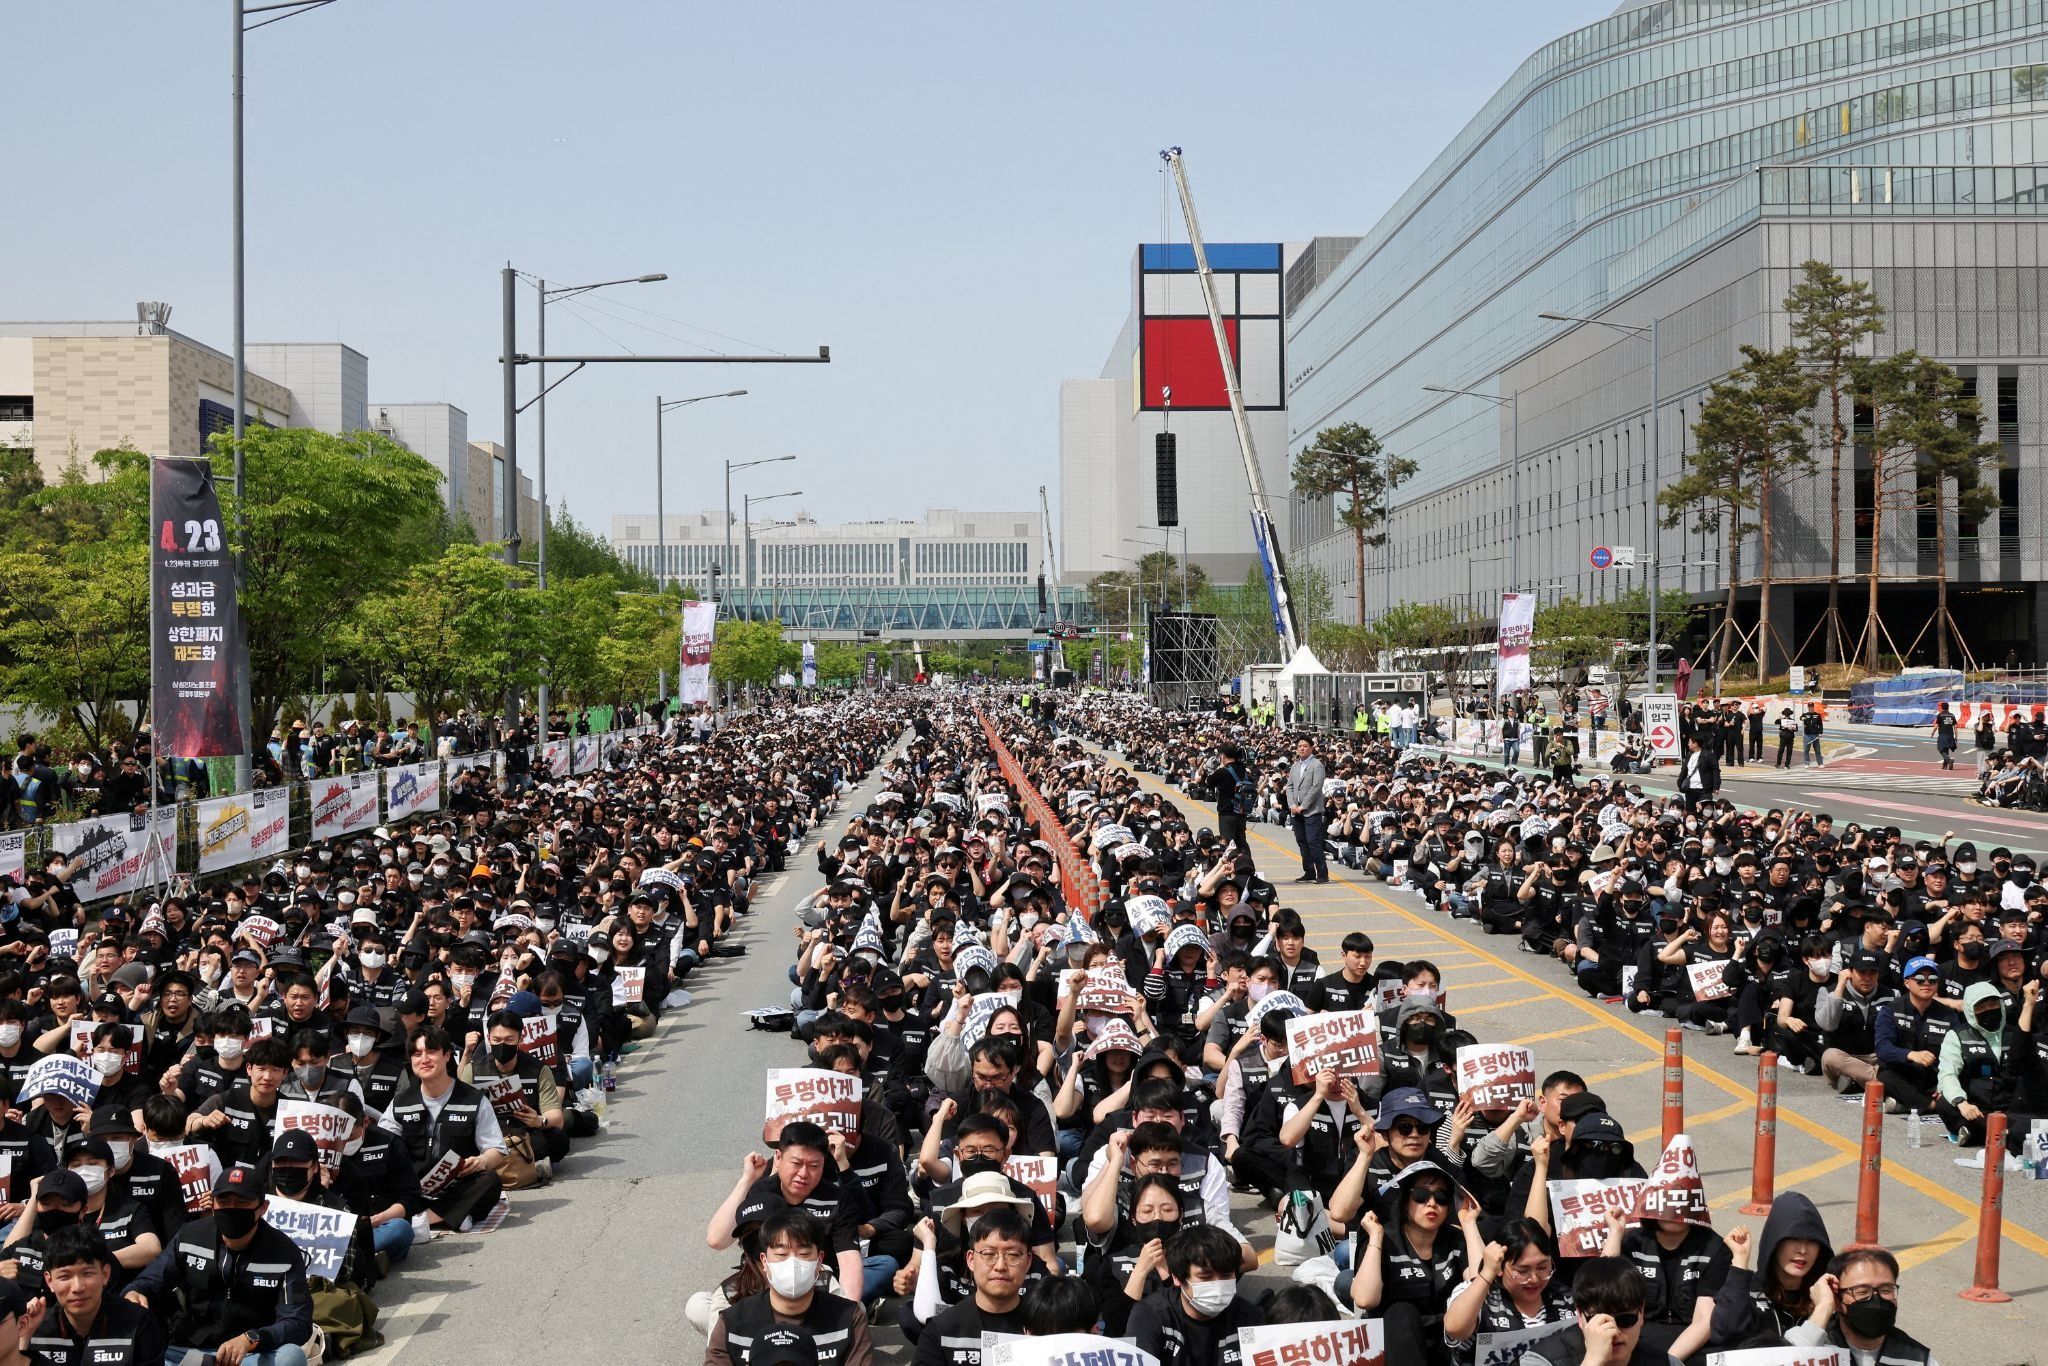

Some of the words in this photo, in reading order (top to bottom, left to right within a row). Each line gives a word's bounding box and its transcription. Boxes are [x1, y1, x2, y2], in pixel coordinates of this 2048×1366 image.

[161, 519, 221, 553] 4.23
[171, 581, 217, 598] 성과급
[171, 601, 216, 617] 투명화
[168, 626, 223, 642] 상한폐지
[174, 645, 216, 661] 제도화
[1651, 713, 1671, 723] 입구
[1692, 962, 1726, 984] 투명하
[522, 1019, 548, 1043] 하게
[1293, 1013, 1365, 1051] 투명하게
[1306, 1045, 1376, 1077] 바꾸고!!!
[1463, 1051, 1529, 1079] 투명하게
[200, 1077, 217, 1088] 투쟁
[371, 1083, 390, 1091] SELU
[775, 1077, 854, 1106] 투명하게
[1473, 1083, 1534, 1105] 바꾸고!!!
[403, 1112, 420, 1122] 투쟁
[1003, 1160, 1045, 1179] 하게
[132, 1188, 155, 1196] SELU
[181, 1179, 209, 1203] 고!!!
[1645, 1188, 1708, 1213] 바꾸고
[742, 1203, 763, 1217] NSEU
[104, 1230, 127, 1239] SELU
[19, 1255, 44, 1270] 투쟁
[186, 1254, 207, 1271] 투쟁
[1400, 1266, 1426, 1280] 투쟁
[252, 1278, 279, 1288] SELU
[93, 1352, 123, 1363] SELU
[818, 1349, 837, 1360] ELU
[953, 1351, 981, 1363] 투쟁
